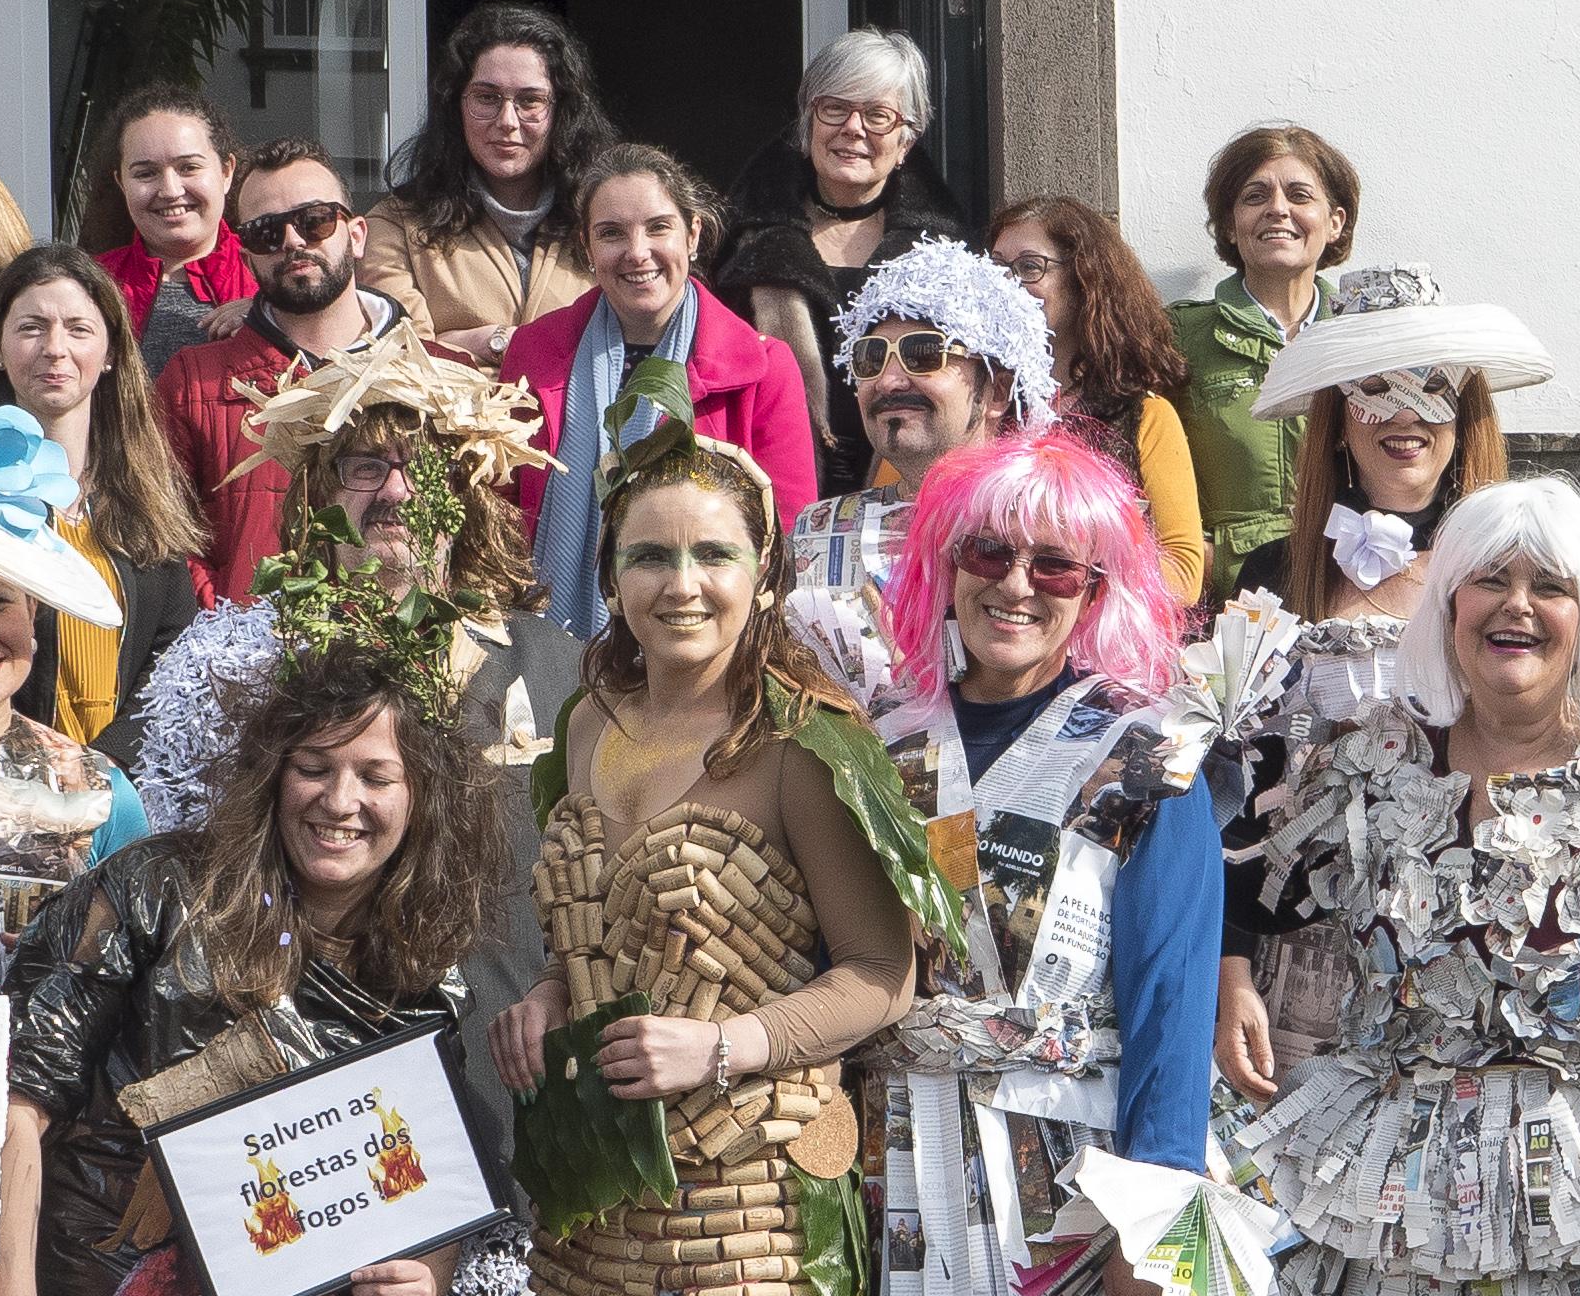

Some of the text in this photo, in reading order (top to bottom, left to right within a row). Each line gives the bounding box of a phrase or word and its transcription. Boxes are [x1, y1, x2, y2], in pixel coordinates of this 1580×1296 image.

[989, 842, 1045, 868] MUNDO
[1051, 932, 1065, 945] DA
[1054, 920, 1077, 935] PARA
[243, 1090, 379, 1158] Salvem as
[239, 1124, 412, 1207] florestas dos
[293, 1189, 370, 1234] fogos
